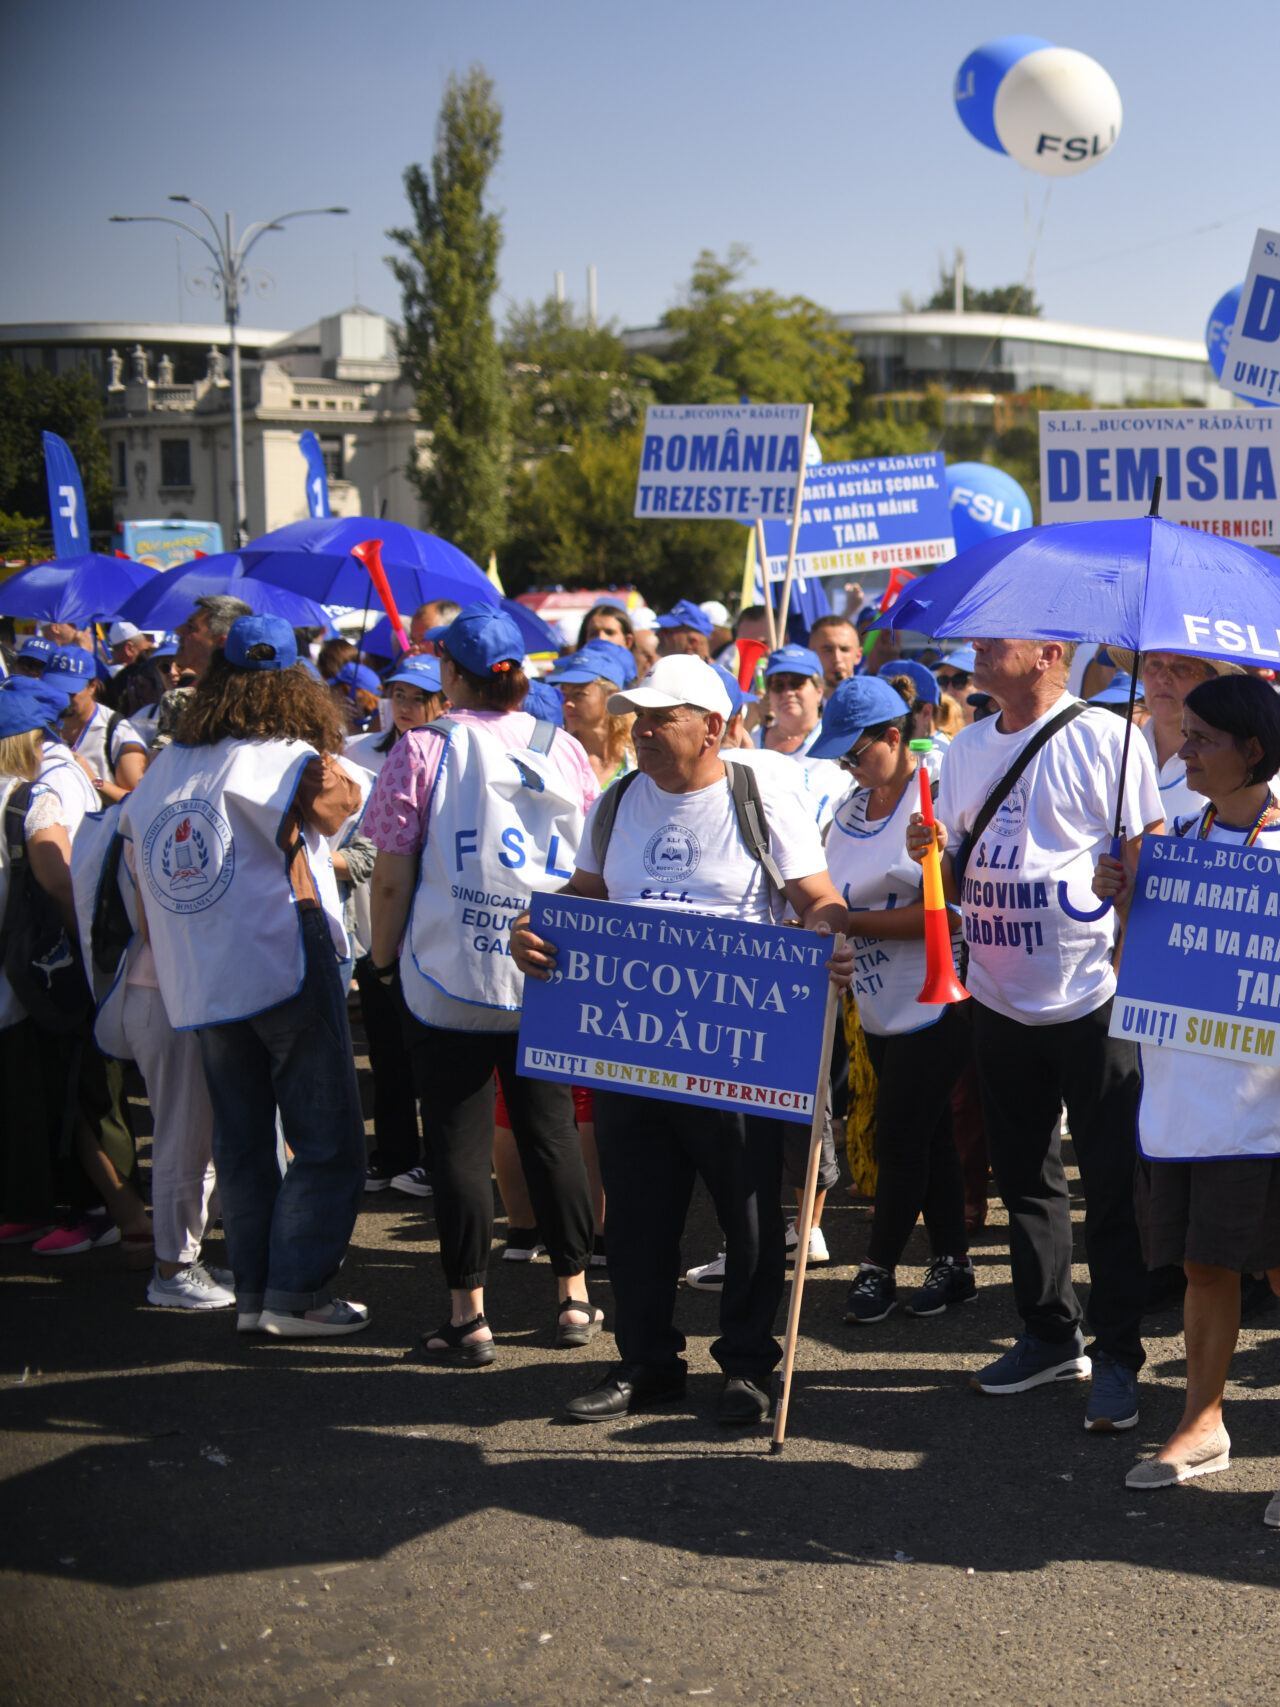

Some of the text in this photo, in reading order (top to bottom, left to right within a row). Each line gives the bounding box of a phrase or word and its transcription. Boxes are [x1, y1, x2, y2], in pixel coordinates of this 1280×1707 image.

[1036, 124, 1115, 162] FSLI
[652, 408, 677, 420] S.L.I.
[1047, 420, 1087, 432] S.L.I.
[1199, 416, 1273, 433] RĂDĂUȚI
[642, 427, 800, 472] ROMÂNIA
[801, 481, 837, 501] RATĂ
[838, 478, 883, 498] ASTĂZI
[1047, 447, 1277, 502] DEMISIA
[639, 485, 796, 514] TREZESTE-TE!
[814, 507, 832, 522] VA
[877, 498, 919, 516] MÂINE
[949, 487, 1021, 532] FSLI
[832, 522, 880, 548] ȚARA
[770, 544, 946, 577] UNȚI SUNTEM PUTERNICI!
[51, 654, 84, 674] FSLI
[975, 845, 1020, 870] S.L.I.
[1152, 842, 1199, 866] S.L.I.
[1145, 875, 1189, 904] CUM
[1193, 882, 1260, 914] ARATĂ
[542, 908, 823, 966] SINDICAT ÎNVĂȚĂMÂNT
[966, 914, 1044, 955] RĂDĂUȚI
[1168, 922, 1208, 956] AȘA
[1215, 929, 1240, 957] VA
[854, 949, 891, 974] ȚIA
[577, 999, 767, 1068] RĂDĂUȚI
[1122, 1006, 1178, 1046] UNIȚI
[1185, 1016, 1276, 1057] SUNTEM
[531, 1050, 809, 1110] UNIȚI SUNTEM PUTERNICI!
